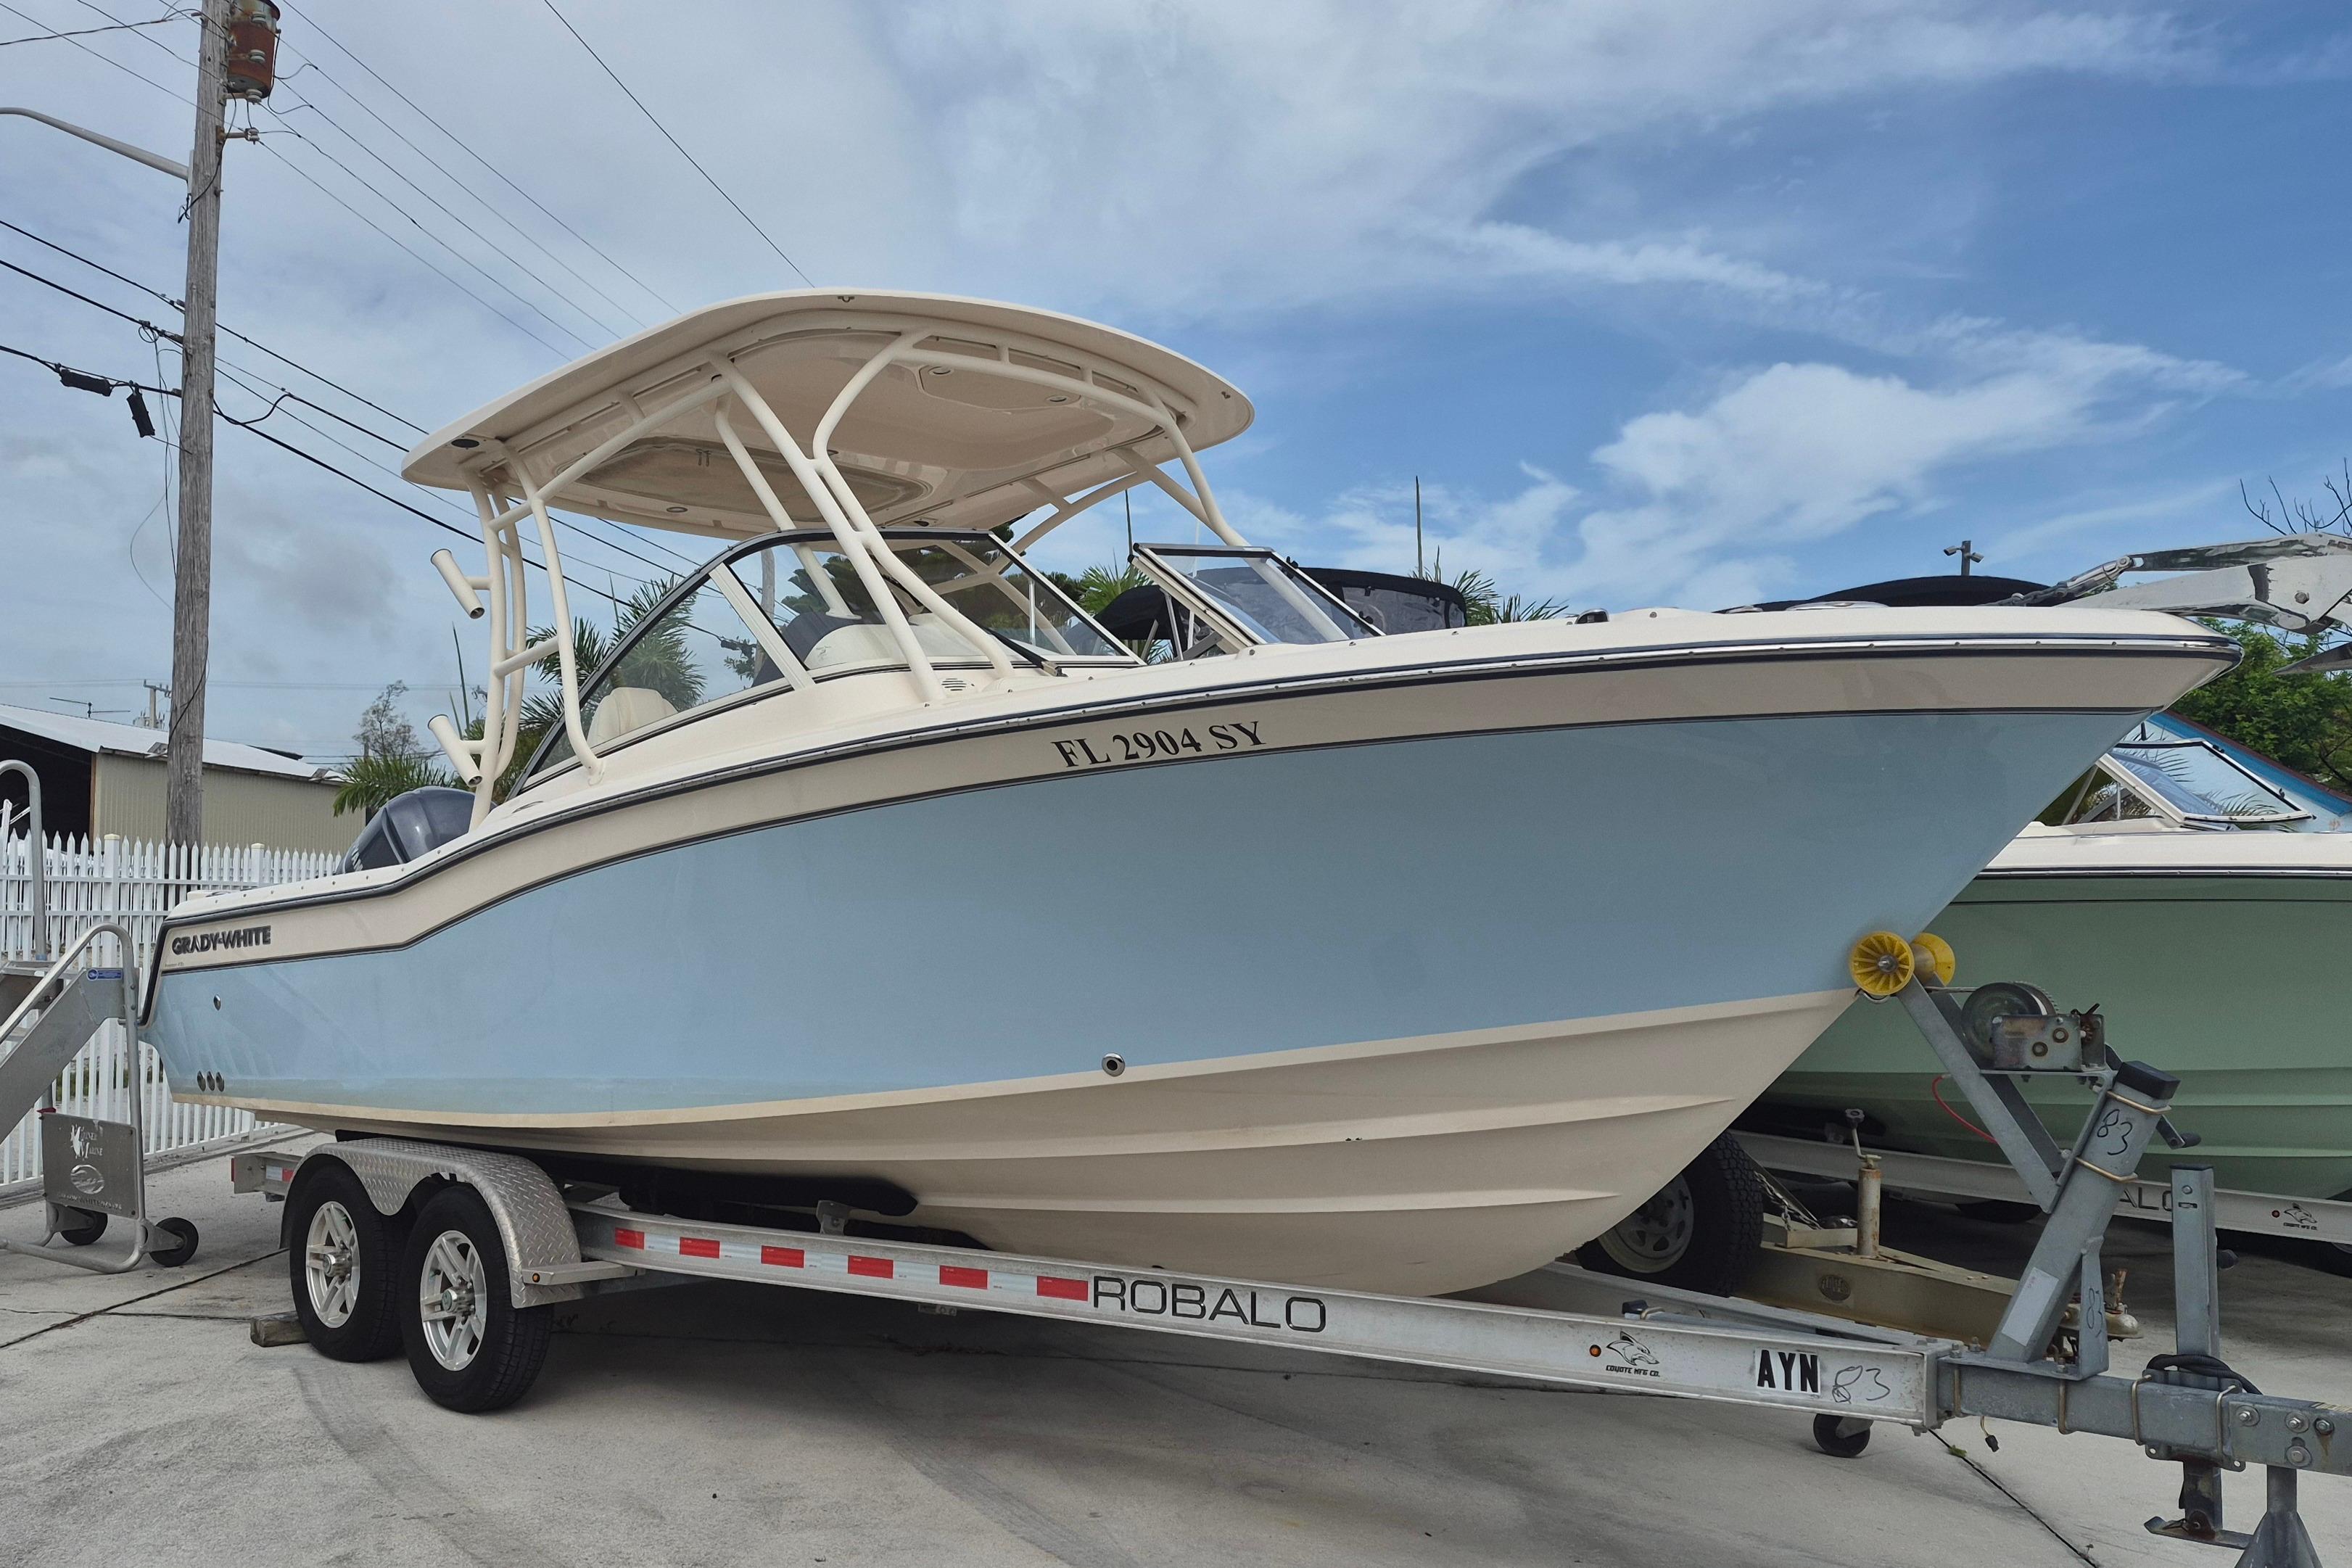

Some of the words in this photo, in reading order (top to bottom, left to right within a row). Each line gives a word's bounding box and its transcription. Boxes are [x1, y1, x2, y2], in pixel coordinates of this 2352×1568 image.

[1051, 738, 1110, 768] FL
[1113, 727, 1202, 761] 2904
[1208, 720, 1267, 751] SY
[171, 925, 272, 956] GRADY-WHITE
[2097, 1108, 2133, 1156] 83
[1093, 1275, 1326, 1333] ROBALO
[1605, 1364, 1633, 1374] COYOTE
[1757, 1349, 1820, 1394] AYN
